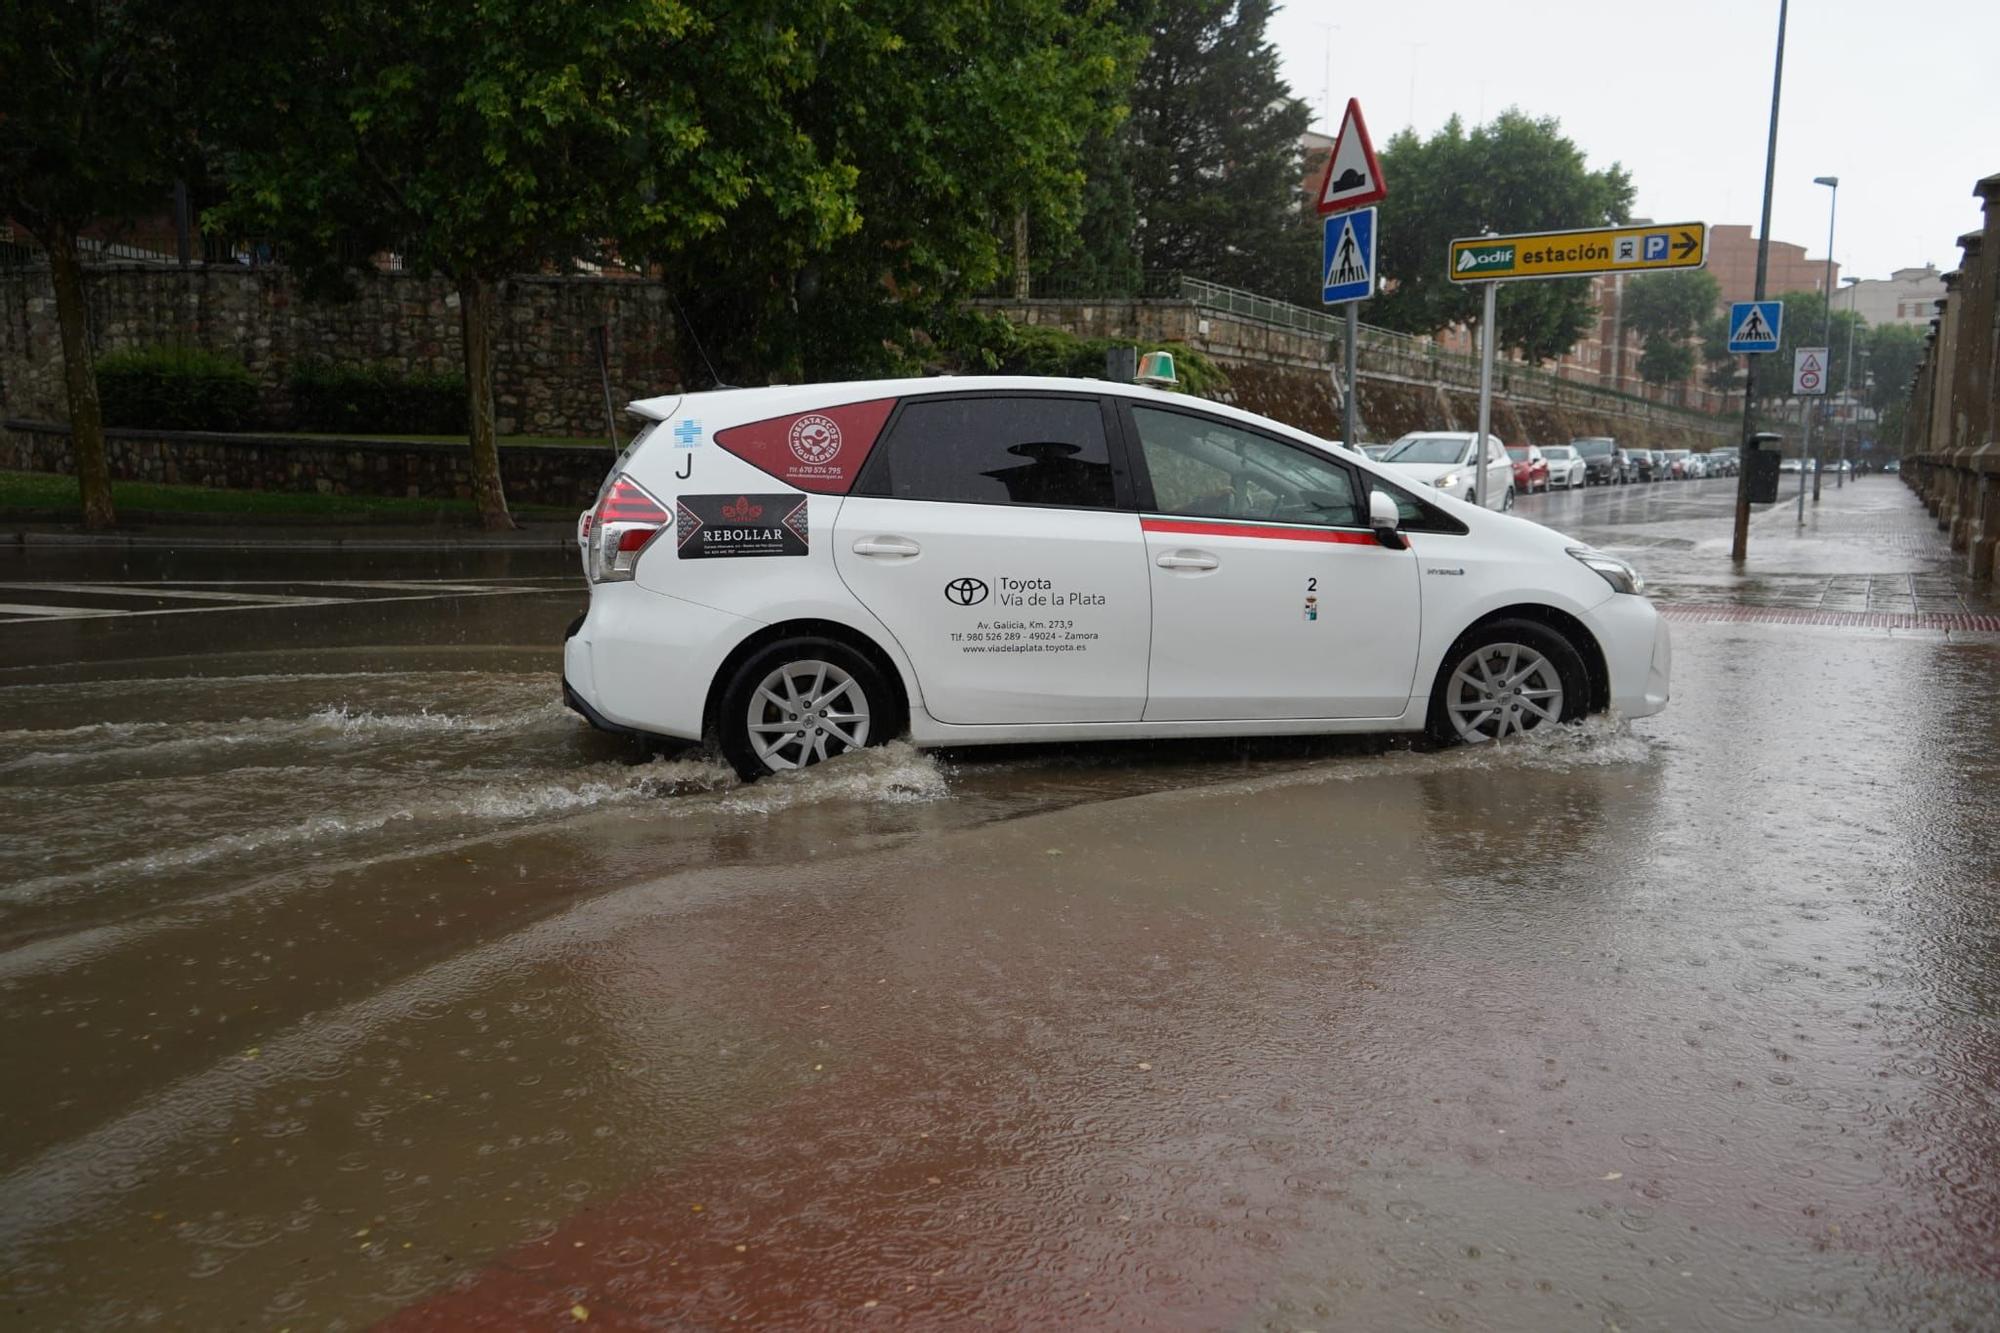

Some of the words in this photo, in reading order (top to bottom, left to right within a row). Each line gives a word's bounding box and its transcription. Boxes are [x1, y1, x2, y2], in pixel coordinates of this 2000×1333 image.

[1477, 249, 1514, 265] adif
[1523, 243, 1609, 265] estación
[1647, 237, 1664, 259] P
[793, 417, 838, 440] DESATASCOS
[674, 452, 693, 481] J
[702, 528, 784, 542] REBOLLAR
[1000, 577, 1052, 591] Toyota
[1306, 577, 1318, 592] 2
[1000, 592, 1024, 606] Vía
[1027, 592, 1048, 606] de
[1051, 592, 1065, 606] la
[1069, 592, 1106, 606] Plata
[976, 621, 991, 630] Av.
[993, 621, 1027, 631] Galicia,
[1028, 621, 1047, 630] Km.
[1048, 620, 1074, 631] 273,9
[966, 633, 984, 641] 980
[985, 633, 1002, 641] 526
[1004, 633, 1022, 641] 289
[1028, 632, 1056, 641] 49024
[1064, 632, 1099, 641] Zamora
[962, 644, 1087, 654] www.viadelaplata.toyota.es
